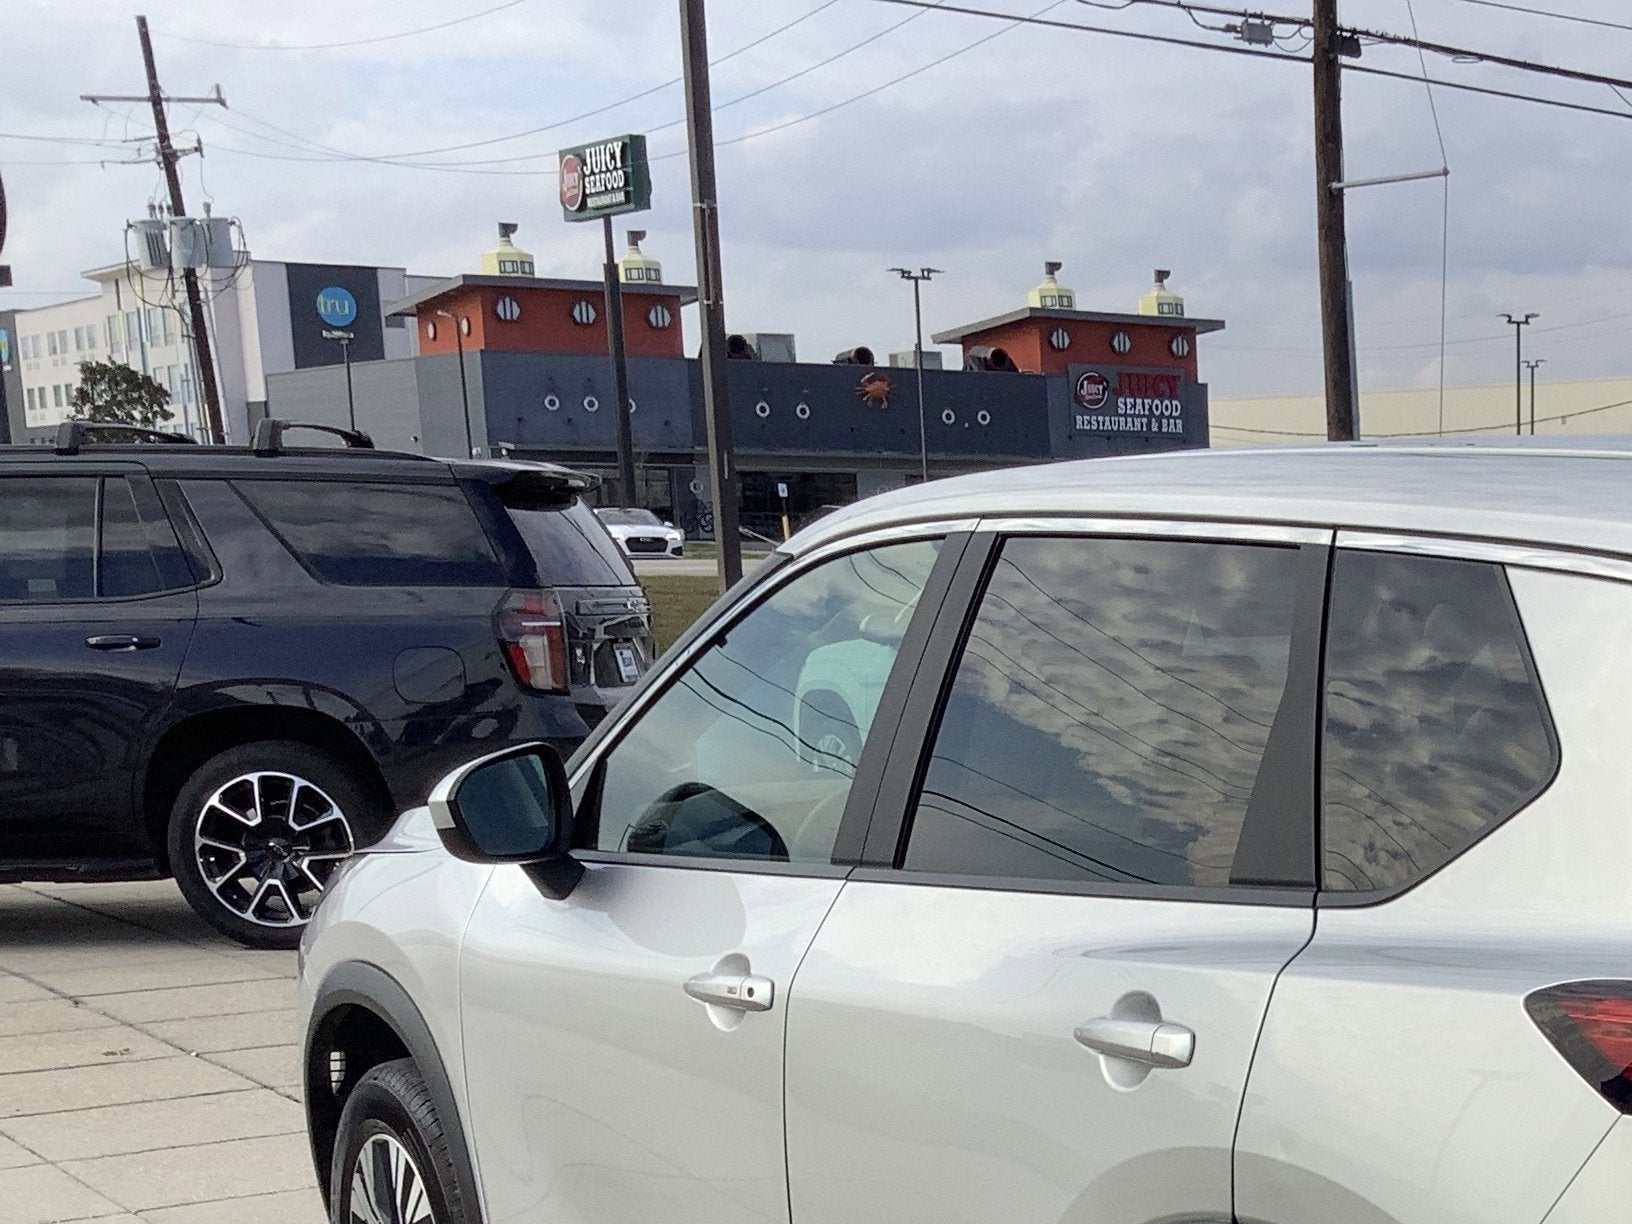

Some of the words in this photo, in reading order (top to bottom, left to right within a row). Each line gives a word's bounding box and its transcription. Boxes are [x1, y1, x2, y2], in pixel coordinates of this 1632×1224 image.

[583, 141, 623, 176] JUICY
[584, 169, 625, 194] SEAFOOD
[1113, 372, 1181, 399] JUICY
[1117, 397, 1182, 417] SEAFOOD
[1076, 415, 1148, 432] RESTAURANT
[1151, 418, 1159, 432] &
[1161, 419, 1184, 433] BAR
